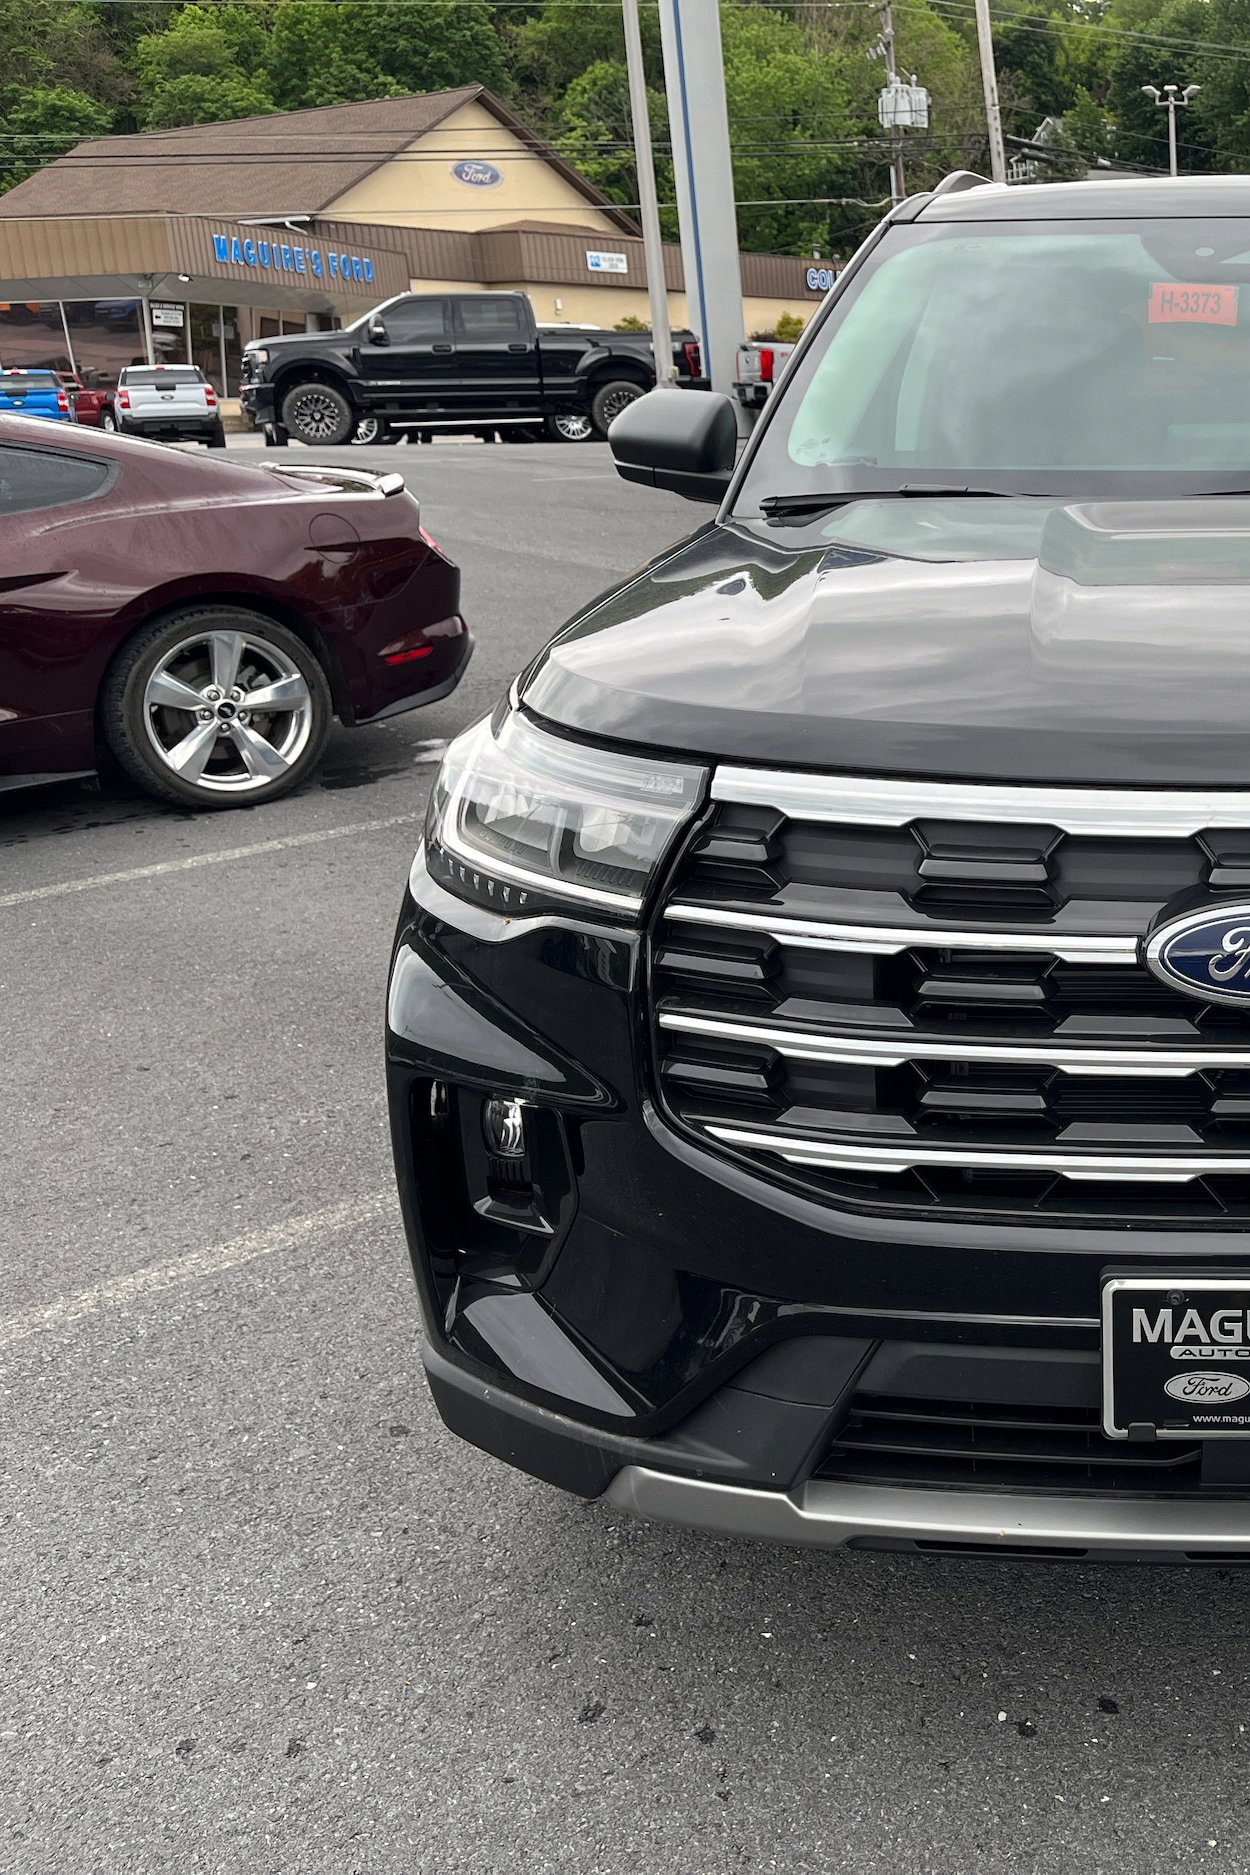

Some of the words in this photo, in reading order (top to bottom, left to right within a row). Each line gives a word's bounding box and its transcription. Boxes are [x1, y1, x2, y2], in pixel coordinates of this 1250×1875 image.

[462, 163, 492, 182] Ford
[213, 234, 323, 277] MAGUIRE'S
[328, 252, 374, 282] FORD
[1160, 288, 1221, 314] H-3373
[1182, 1377, 1233, 1396] Ford
